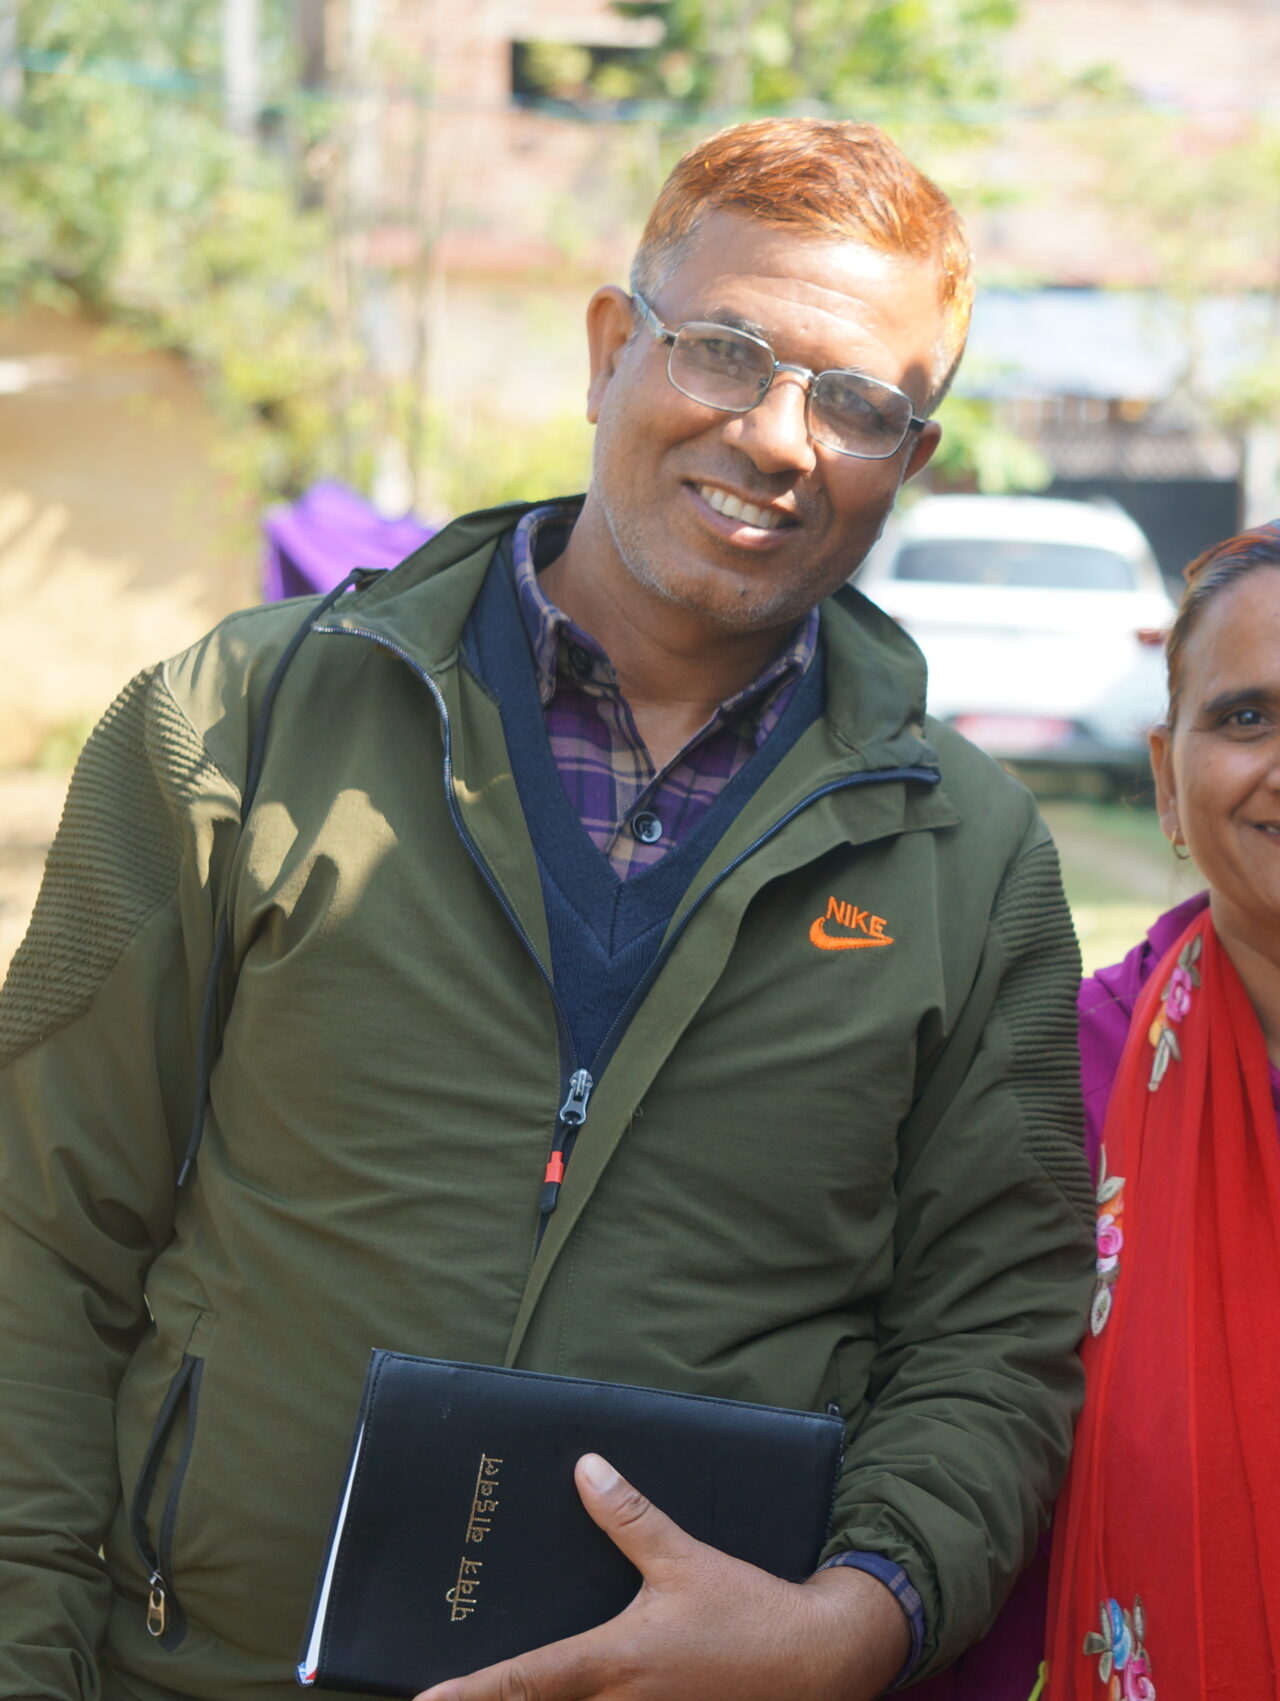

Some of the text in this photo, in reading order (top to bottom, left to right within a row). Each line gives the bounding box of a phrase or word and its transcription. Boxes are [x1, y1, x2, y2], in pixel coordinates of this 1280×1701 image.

[826, 896, 888, 939] NIKE
[446, 1453, 503, 1621] पवित्र बाइबल
